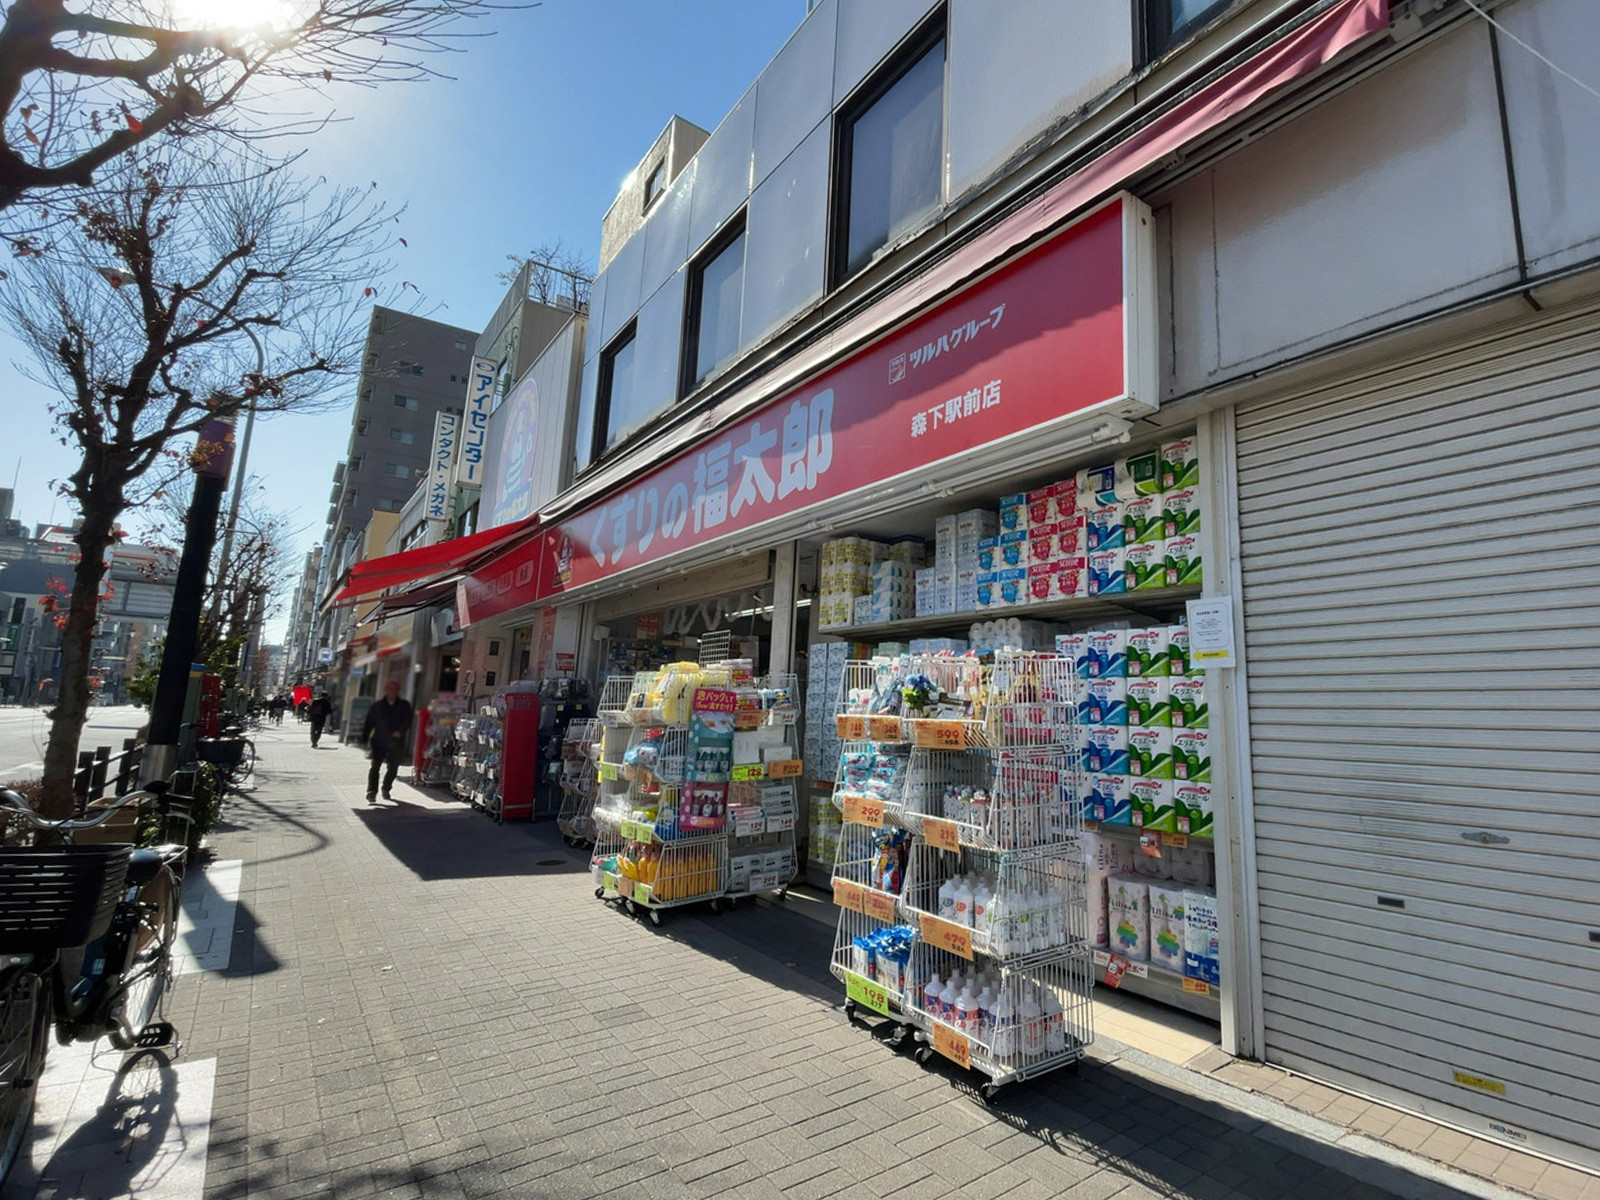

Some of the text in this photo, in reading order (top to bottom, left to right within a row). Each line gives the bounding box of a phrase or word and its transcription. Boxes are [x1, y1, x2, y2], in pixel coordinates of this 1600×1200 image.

[909, 303, 1006, 369] ツルハグループ
[911, 379, 1002, 437] 森下駅前店
[465, 373, 492, 480] アイセンター
[429, 414, 455, 517] コンタクト・メガネ
[589, 388, 835, 568] くすりの福太郎
[1131, 638, 1157, 646] エリエール
[1131, 687, 1157, 696] エリエール
[1174, 687, 1203, 696] エリエール
[936, 729, 960, 740] 599
[1132, 737, 1158, 746] エリエール
[1177, 738, 1207, 748] エリエール
[747, 767, 762, 777] 128
[1133, 787, 1161, 797] エリエール
[1179, 792, 1210, 803] エリエール
[861, 806, 880, 818] 299
[940, 829, 956, 842] 279
[944, 931, 967, 946] 479
[862, 985, 885, 1004] 198
